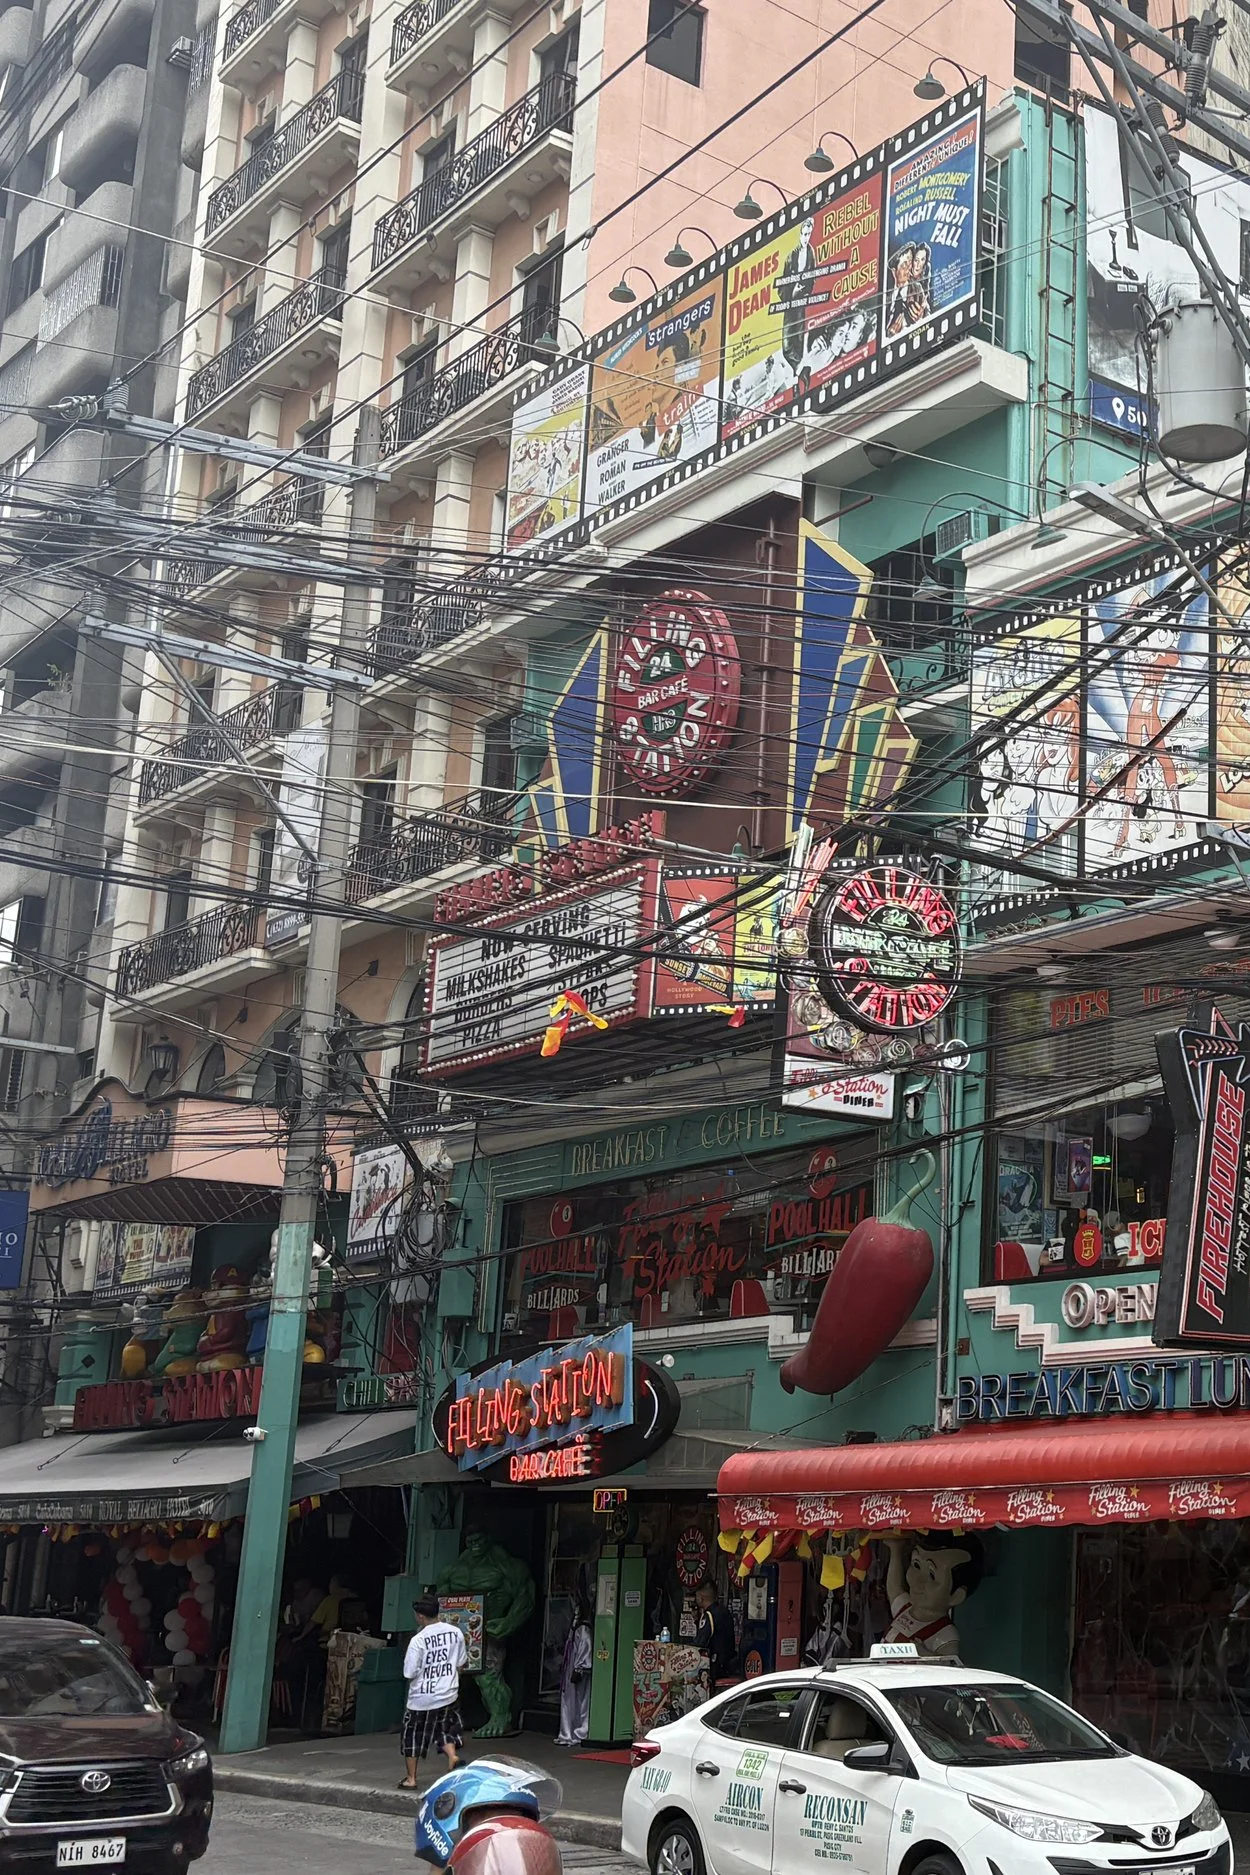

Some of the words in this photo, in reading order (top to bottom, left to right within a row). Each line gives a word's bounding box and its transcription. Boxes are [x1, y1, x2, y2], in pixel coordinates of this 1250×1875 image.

[895, 184, 918, 203] ROBERT
[918, 171, 971, 191] MONTGOMERY
[895, 196, 923, 215] ROSALIND
[924, 186, 957, 202] RUSSELL
[823, 192, 872, 238] REBEL
[894, 201, 936, 236] NIGHT
[934, 201, 970, 223] MUST
[816, 210, 880, 264] WITHOUT
[930, 222, 963, 248] FALL
[850, 245, 859, 268] A
[729, 250, 780, 300] JAMES
[833, 258, 879, 301] CAUSE
[728, 284, 772, 336] DEAN
[908, 323, 930, 341] KODAK
[597, 439, 630, 468] GRANGER
[600, 460, 626, 485] ROMAN
[598, 480, 626, 504] WALKER
[618, 611, 706, 692] FILLING
[650, 652, 672, 678] 24
[638, 690, 659, 710] BAR
[839, 869, 956, 936] FILLING
[883, 909, 910, 928] 24
[481, 929, 517, 962] NOW
[524, 905, 590, 947] SERVING
[548, 921, 627, 969] SPAGHETTI
[446, 955, 527, 1001] MILKSHAKES
[664, 958, 691, 975] SUNSET
[1049, 989, 1111, 1032] PIES
[462, 1018, 501, 1047] PIZZA
[833, 1076, 889, 1096] Station
[843, 1094, 875, 1108] DINER
[701, 1102, 787, 1149] COFFEE
[572, 1125, 667, 1176] BREAKFAST
[1196, 1069, 1246, 1325] FIREHOUSE
[768, 1187, 867, 1245] POOLHALL
[518, 1235, 597, 1278] POOLHALL
[780, 1248, 842, 1277] BILLIAR
[527, 1286, 580, 1312] BILLIARDS
[1062, 1281, 1158, 1330] OPEN
[529, 1350, 615, 1427] STATION
[957, 1360, 1179, 1419] BREAKFAST
[448, 1378, 523, 1454] FILLING
[509, 1455, 540, 1482] BAR
[734, 1494, 764, 1517] Filling
[796, 1494, 827, 1517] Filling
[860, 1493, 893, 1516] Filling
[931, 1491, 965, 1516] Filling
[1007, 1489, 1045, 1516] Filling
[1088, 1483, 1127, 1510] Filling
[1168, 1479, 1211, 1507] Filling
[1177, 1493, 1237, 1515] Station
[100, 1500, 124, 1521] ROYAL
[166, 1496, 191, 1518] HOTEL
[740, 1508, 779, 1526] Station
[801, 1508, 843, 1526] Station
[867, 1507, 912, 1526] Station
[938, 1501, 986, 1525] Station
[1013, 1503, 1066, 1523] Station
[1094, 1497, 1152, 1517] Station
[678, 1527, 707, 1554] FILLING
[676, 1558, 707, 1586] STATION
[424, 1631, 458, 1650] PRETTY
[880, 1645, 913, 1655] TAXI
[425, 1648, 448, 1665] EYES
[746, 1658, 761, 1675] GULF
[423, 1663, 453, 1679] NEVER
[420, 1680, 436, 1695] LIE
[743, 1758, 762, 1771] 1342
[725, 1782, 764, 1811] AIRCON
[803, 1793, 868, 1827] RECONSAN
[60, 1846, 84, 1862] NIH
[91, 1843, 124, 1860] 8467
